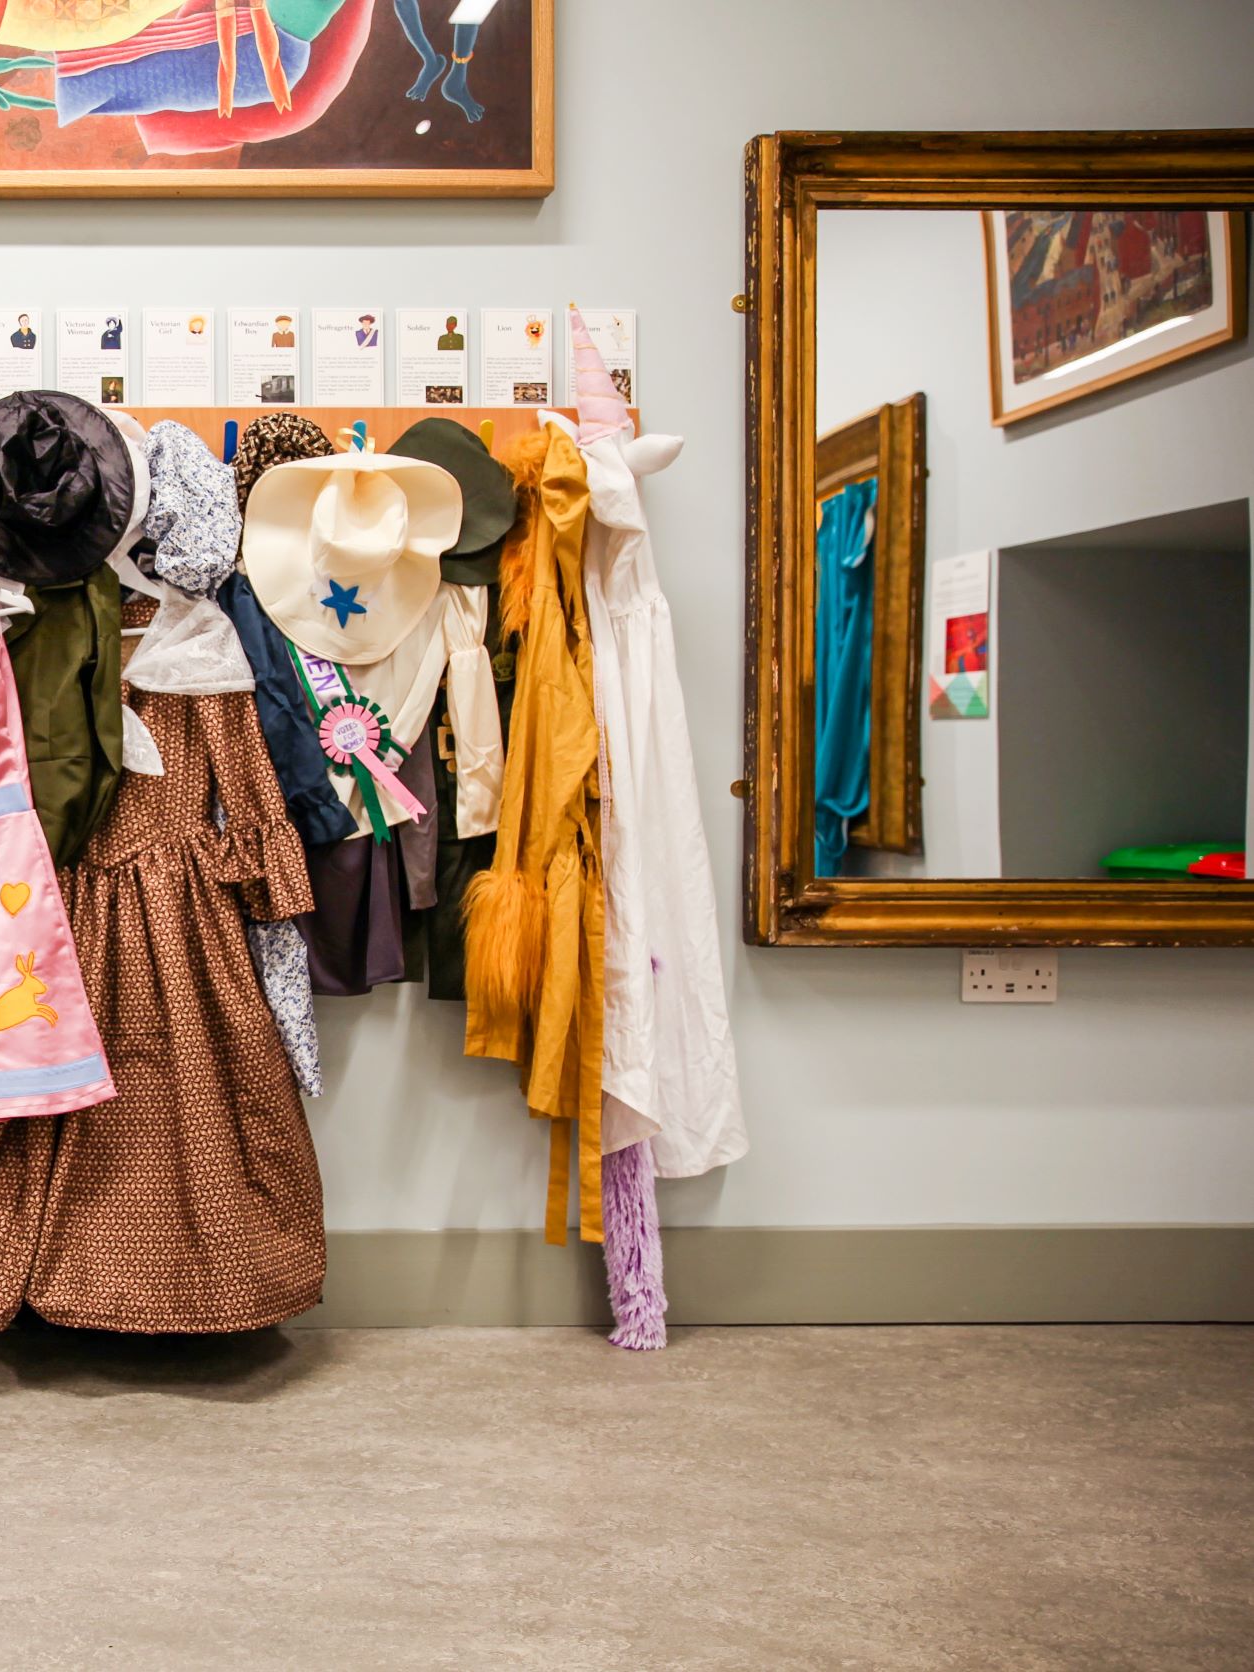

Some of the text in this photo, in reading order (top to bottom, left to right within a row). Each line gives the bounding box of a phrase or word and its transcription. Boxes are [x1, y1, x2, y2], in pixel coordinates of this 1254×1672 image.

[245, 328, 258, 336] Boy
[318, 324, 354, 332] Suffragette
[497, 324, 512, 332] Lion
[304, 655, 340, 692] EN
[336, 721, 359, 737] VOTES
[343, 731, 357, 741] FOR
[341, 736, 365, 751] WOMEN
